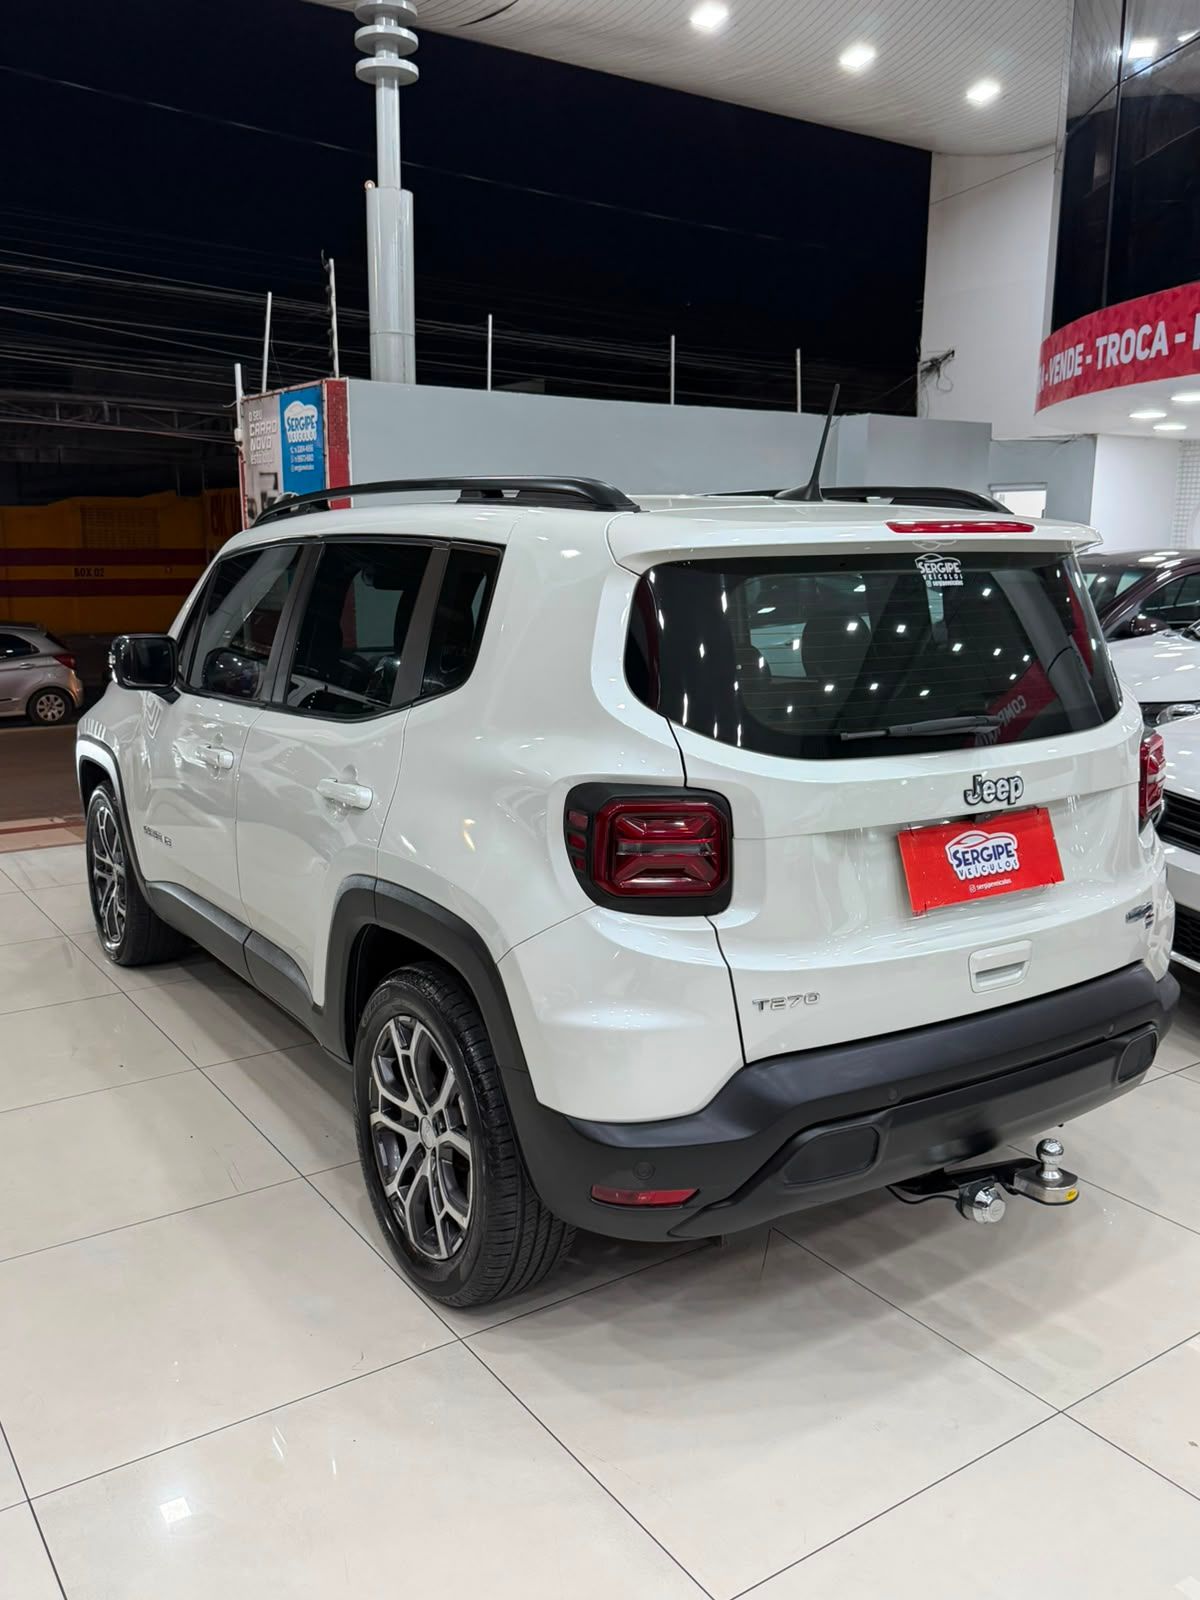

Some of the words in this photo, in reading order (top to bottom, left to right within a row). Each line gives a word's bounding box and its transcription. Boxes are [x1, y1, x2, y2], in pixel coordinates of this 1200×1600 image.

[1049, 343, 1085, 387] VENDE
[1095, 320, 1169, 371] TROCA
[286, 415, 315, 431] SERGIPE
[918, 561, 962, 574] SERGIPE
[964, 774, 1024, 805] Jeep
[952, 842, 1015, 868] SERGIPE
[751, 992, 820, 1012] T270
